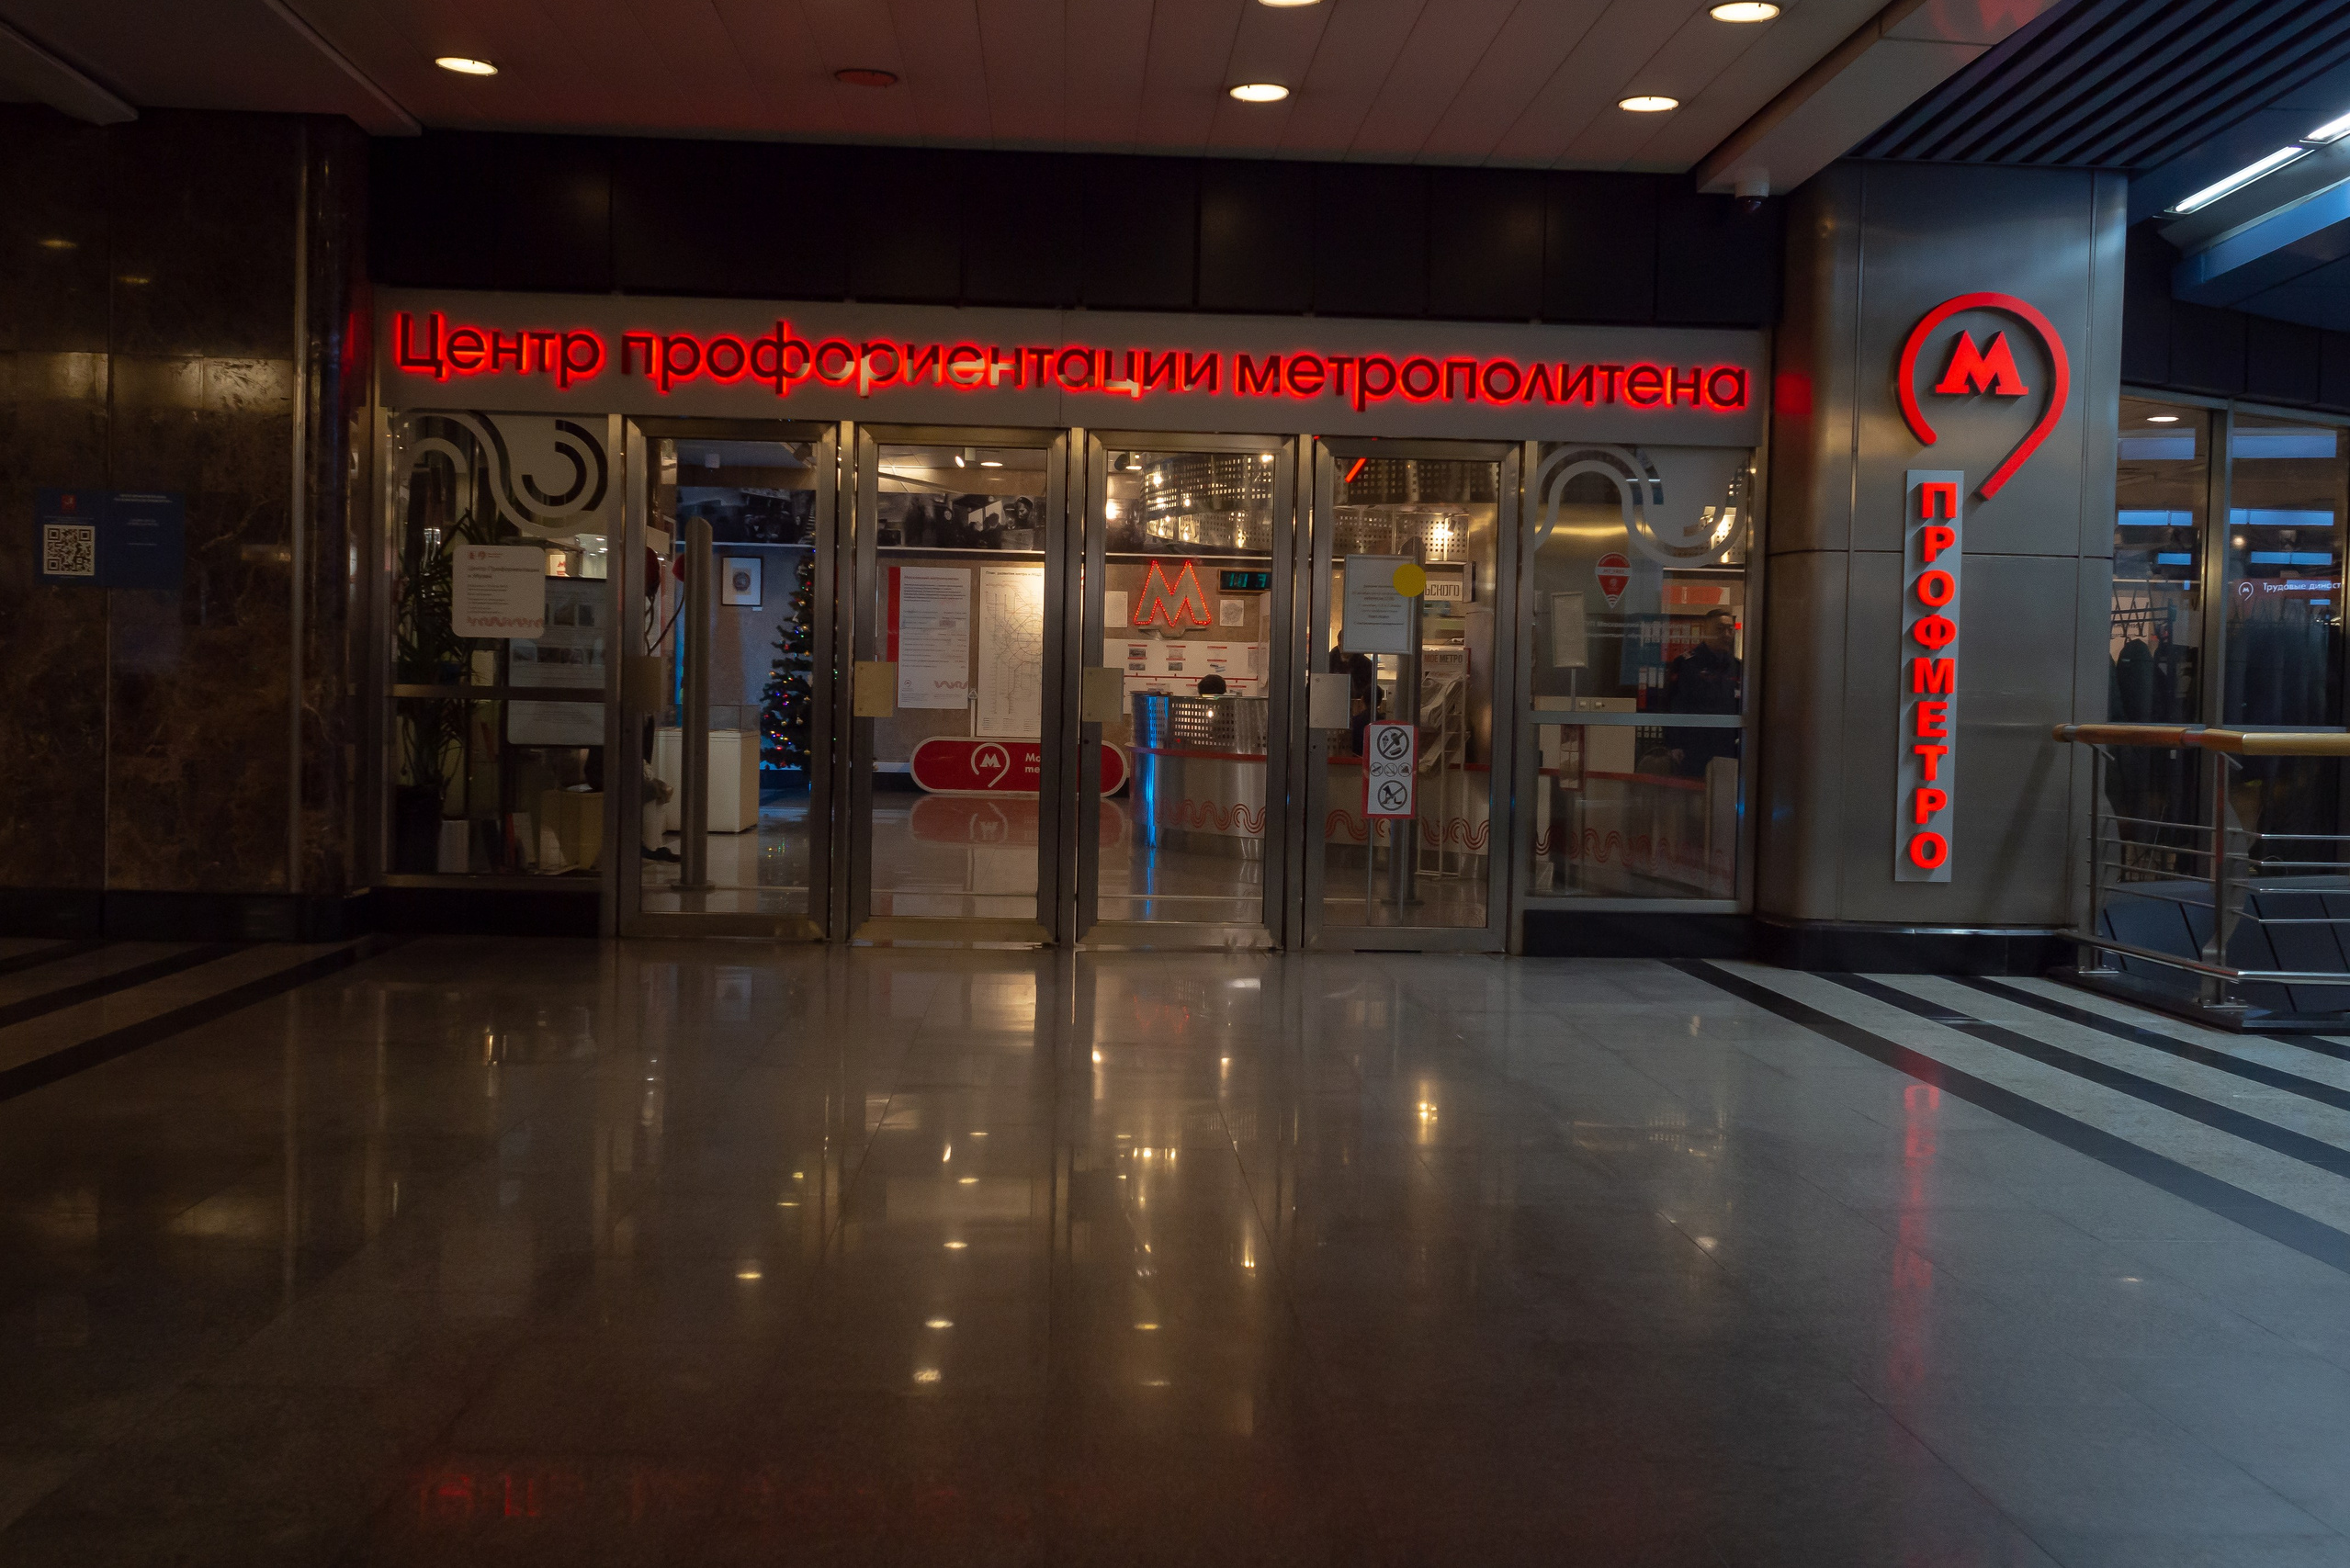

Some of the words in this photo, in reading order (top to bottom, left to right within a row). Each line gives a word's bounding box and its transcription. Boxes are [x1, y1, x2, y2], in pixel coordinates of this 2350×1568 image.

[397, 311, 602, 389] Центр
[621, 320, 1221, 400] профориентации
[1235, 350, 1749, 412] метрополитена
[1935, 330, 2029, 396] М
[1133, 558, 1213, 627] М
[2263, 581, 2307, 593] Трудовые
[1439, 654, 1463, 664] МЕТРО
[1909, 481, 1960, 870] ПРОФМЕТРО
